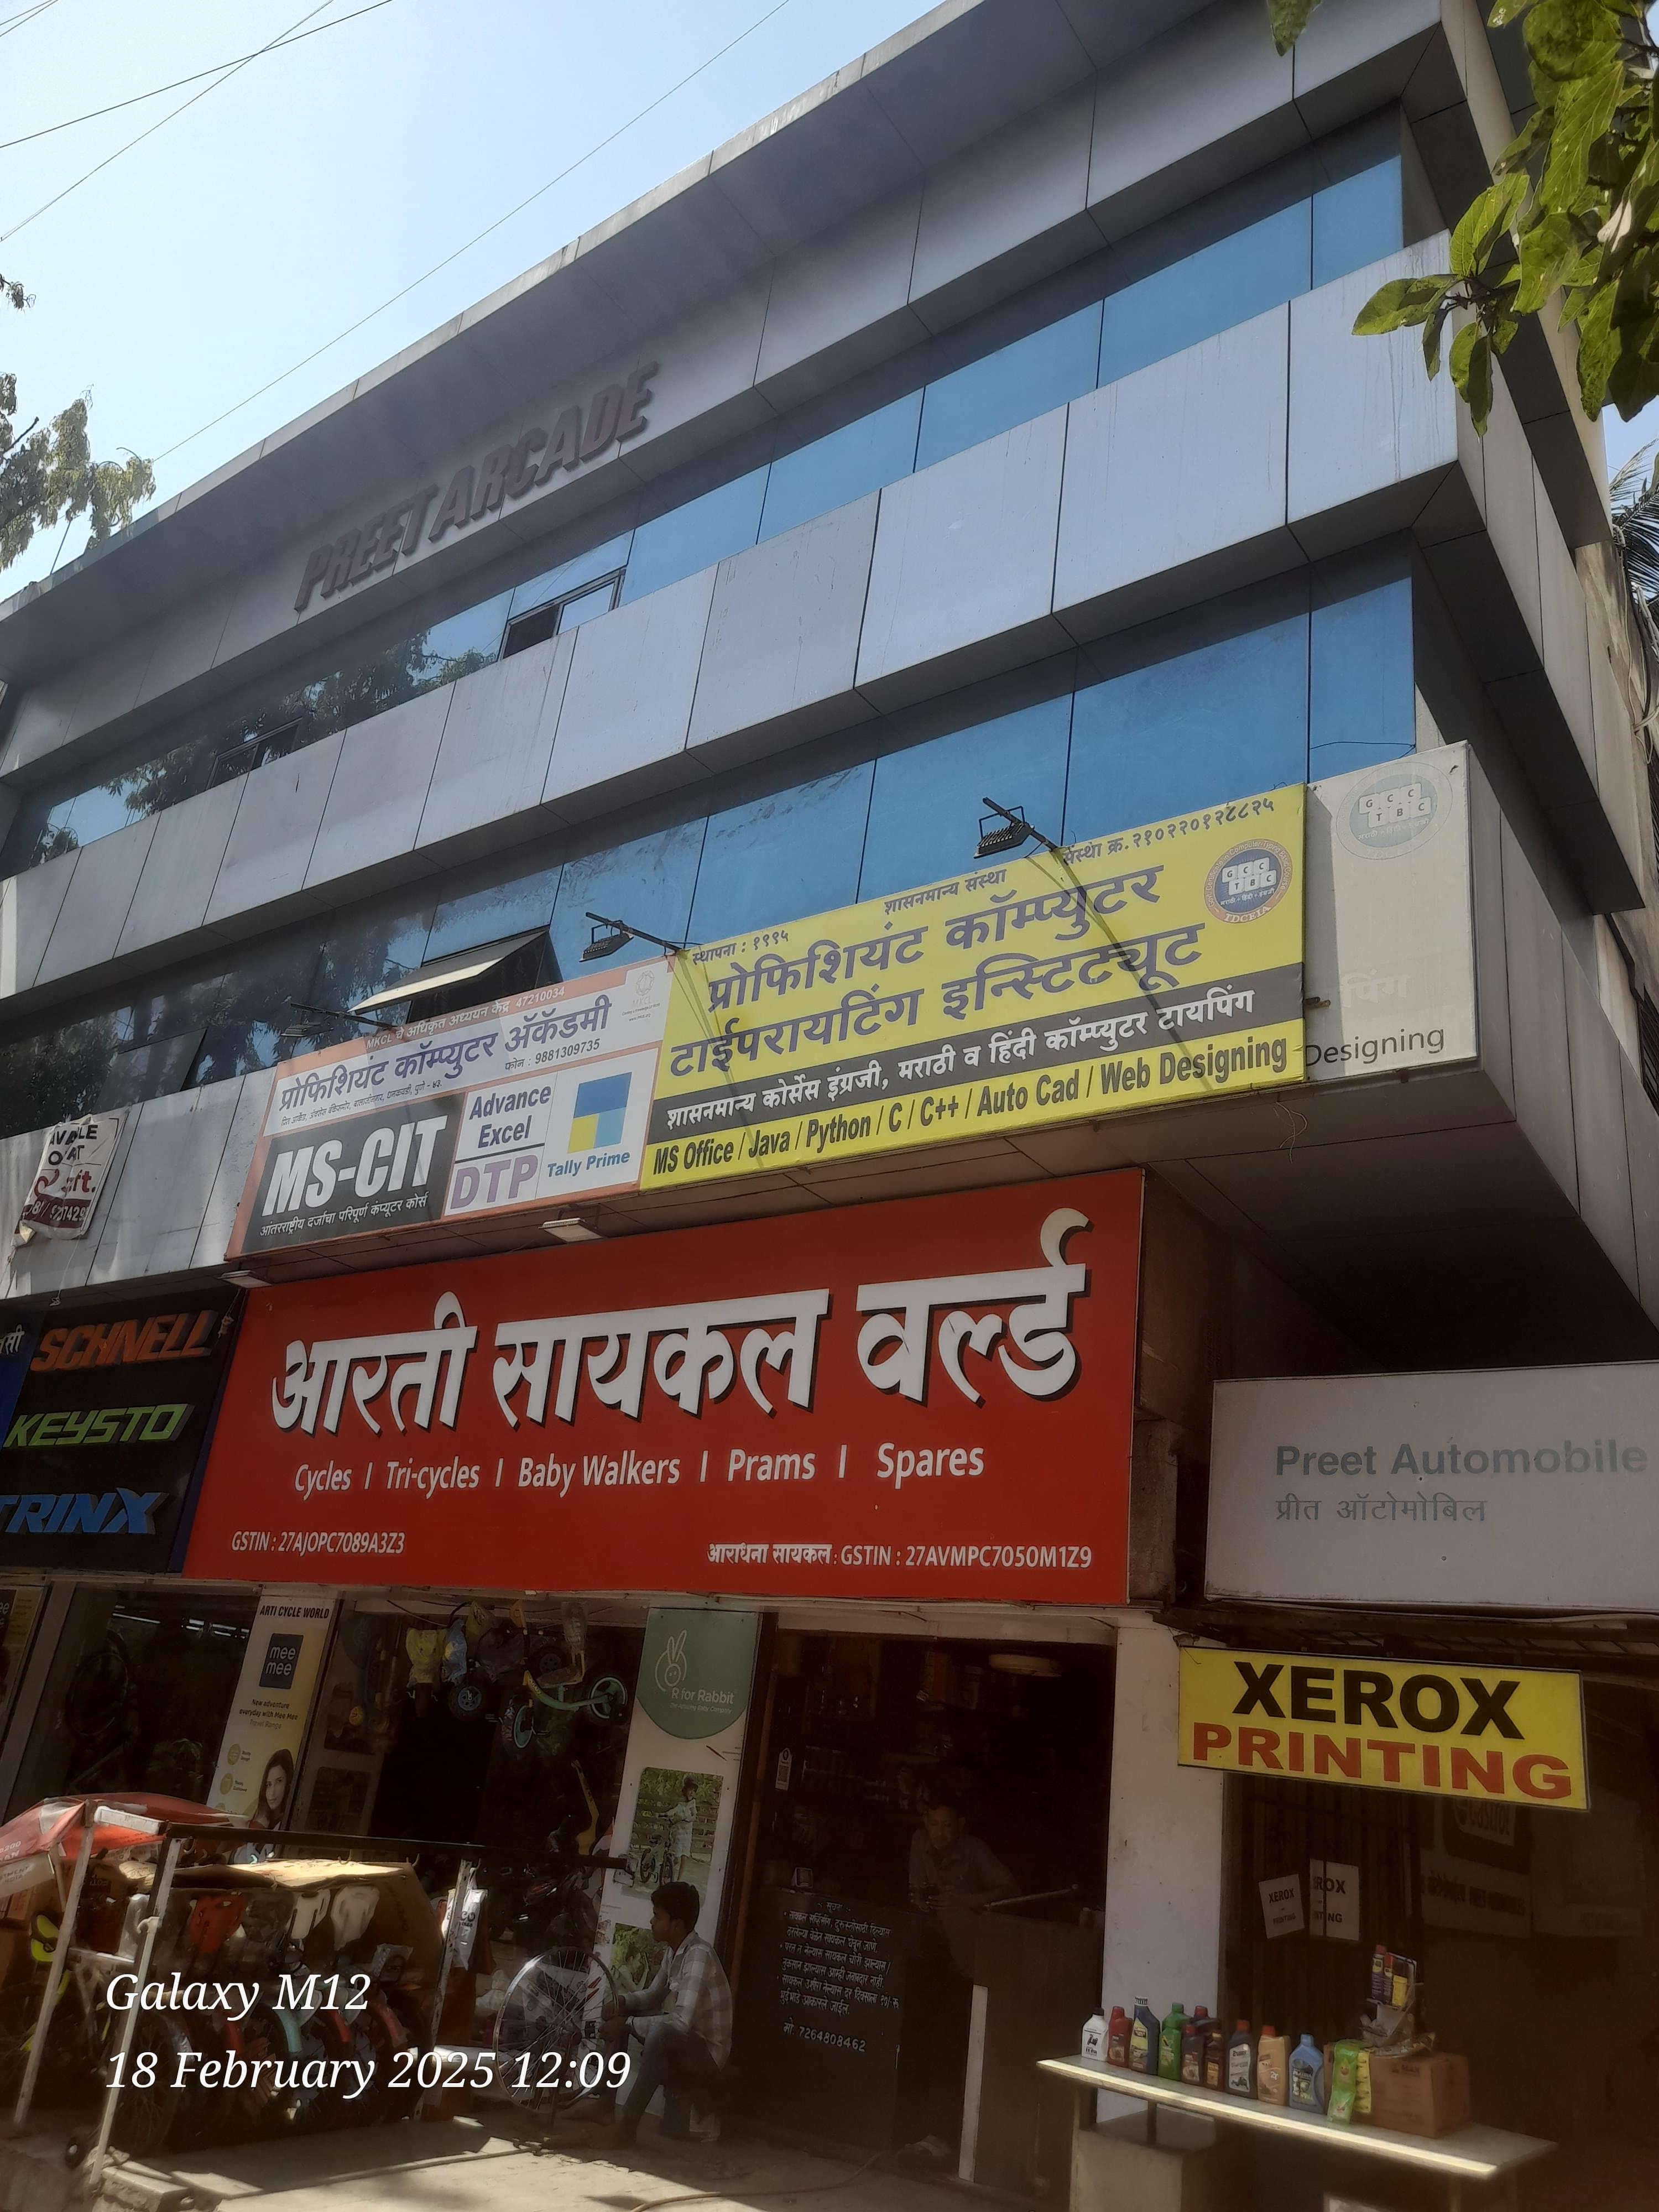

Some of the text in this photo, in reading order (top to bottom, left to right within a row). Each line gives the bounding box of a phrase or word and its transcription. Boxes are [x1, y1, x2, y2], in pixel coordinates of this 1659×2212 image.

[294, 361, 660, 613] PREET ARCADE
[885, 867, 1008, 916] शासनमान्य संस्था
[707, 921, 930, 1014] प्रोफिशियंट
[366, 1036, 393, 1050] MKCL
[448, 1008, 488, 1026] अध्ययन
[515, 986, 566, 1008] 47210034
[670, 983, 925, 1077] टाईपरायटिंग
[505, 1040, 600, 1071] फोन 9881309735
[666, 1091, 757, 1131] शासनमान्य
[762, 1071, 820, 1109] कोर्सेस
[898, 1044, 956, 1079] मराठी
[964, 1047, 981, 1067] व
[989, 1025, 1037, 1066] हिंदी
[1156, 984, 1255, 1032] टायपिंग
[1306, 1029, 1444, 1066] Designing
[469, 1084, 551, 1120] Advance
[653, 1146, 680, 1176] MS
[684, 1136, 735, 1170] Office
[748, 1127, 791, 1159] Java
[806, 1114, 872, 1153] Python
[888, 1102, 903, 1133] C
[920, 1093, 960, 1128] C++
[977, 1079, 1028, 1118] Auto
[1036, 1066, 1080, 1104] Cad
[1100, 1056, 1150, 1095] Web
[1159, 1035, 1288, 1087] Designing
[478, 1115, 531, 1149] Excel
[262, 1115, 447, 1218] MS-CIT
[451, 1155, 538, 1210] DTP
[547, 1150, 630, 1180] Tally Prime
[406, 1191, 429, 1209] कोर्स
[30, 1310, 219, 1372] SCHNELL
[271, 1207, 1094, 1435] आरती सायकल वर्ल्ड
[2, 1403, 195, 1448] KEYSTO
[294, 1442, 985, 1501] Cycles Tri-cycles Baby Walkers Prams Spares
[1275, 1439, 1648, 1477] Preet Automobile
[0, 1488, 168, 1535] TRINX
[1275, 1491, 1488, 1522] प्रीत ऑटोमोबिल
[231, 1531, 269, 1552] GSTIN
[773, 1543, 832, 1566] सायकल
[841, 1546, 891, 1568] GSTIN
[260, 1605, 330, 1619] ARTI CYCLE WORLD
[265, 1661, 293, 1676] mee
[269, 1645, 296, 1661] mee
[671, 1687, 735, 1704] R for Rabbit
[1233, 1661, 1526, 1741] XEROX
[1192, 1722, 1573, 1801] PRINTING
[1268, 1887, 1295, 1904] XEROX
[798, 2025, 867, 2053] 7264808462
